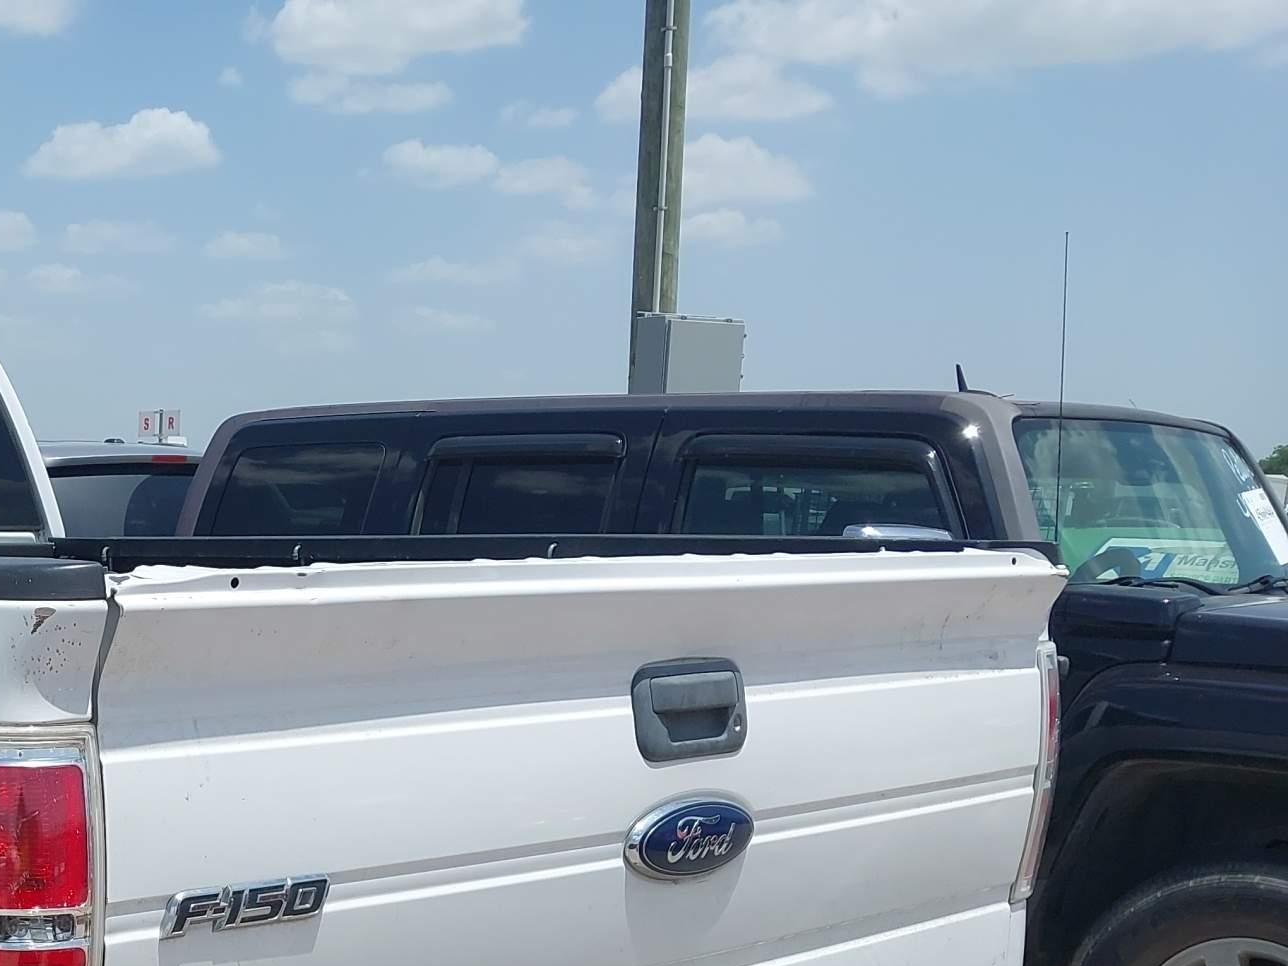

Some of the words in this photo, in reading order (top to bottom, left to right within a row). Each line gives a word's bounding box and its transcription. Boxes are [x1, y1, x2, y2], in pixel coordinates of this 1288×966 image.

[143, 417, 150, 431] S
[167, 416, 175, 430] R
[667, 815, 736, 864] Ford
[162, 874, 330, 938] F-150
